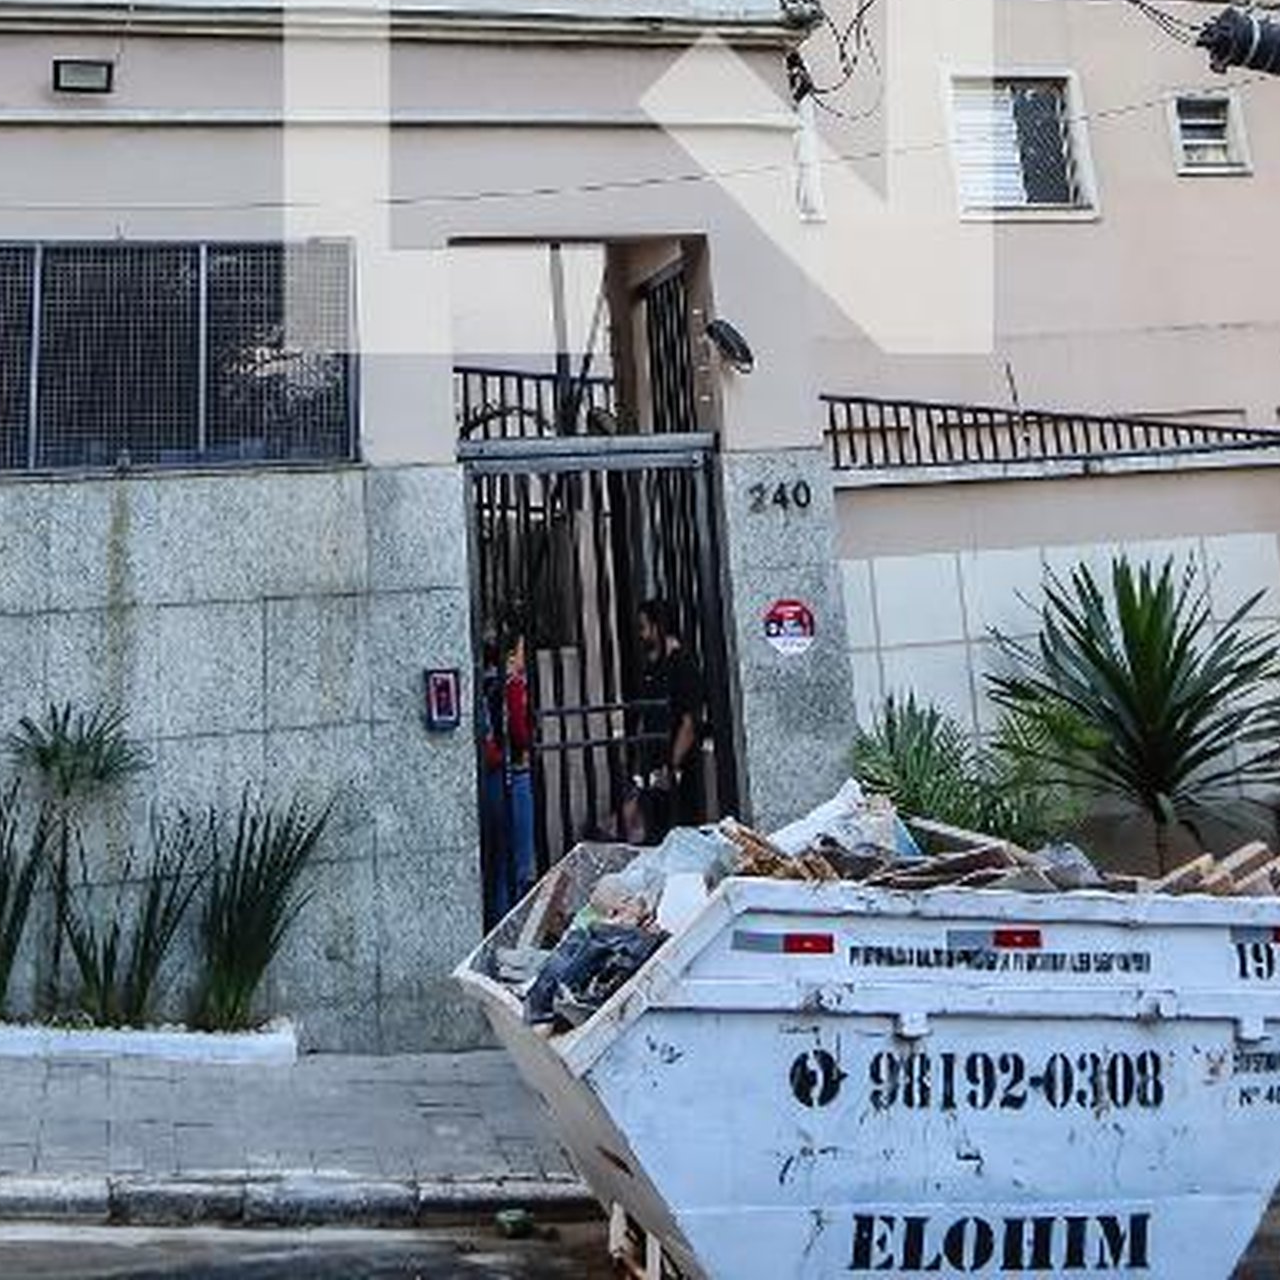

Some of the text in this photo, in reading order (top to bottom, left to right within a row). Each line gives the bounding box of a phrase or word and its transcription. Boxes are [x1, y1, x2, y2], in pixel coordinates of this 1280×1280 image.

[748, 480, 812, 513] 240
[1235, 942, 1276, 980] 19
[868, 1049, 1165, 1111] 98192-0308
[848, 1212, 1152, 1272] ELOHIM
